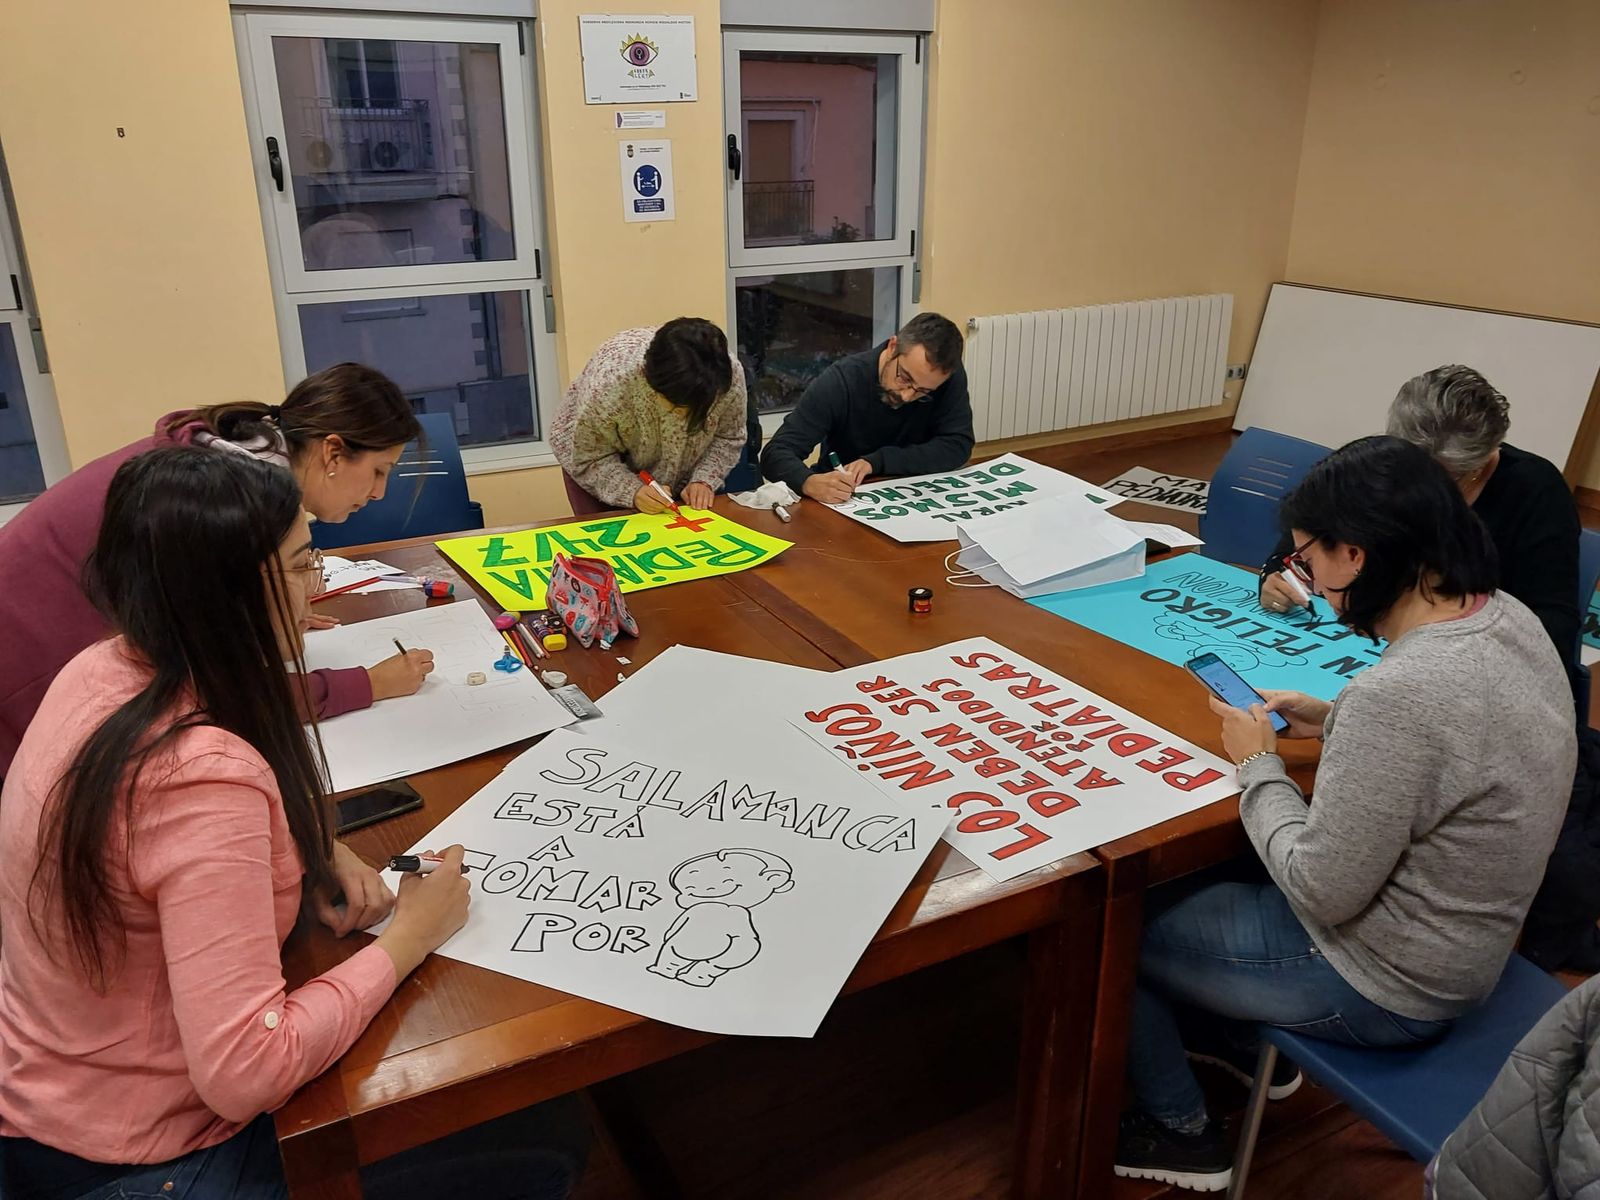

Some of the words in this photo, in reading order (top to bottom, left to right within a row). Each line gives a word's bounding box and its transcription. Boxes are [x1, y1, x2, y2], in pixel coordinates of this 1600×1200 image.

[853, 480, 1039, 521] MISMOS
[1151, 475, 1207, 492] MA
[478, 520, 651, 568] 24/7
[485, 534, 768, 600] PEDIAIA
[1140, 588, 1323, 657] PELIGRO
[1162, 571, 1354, 641] EXTNCION
[856, 675, 939, 717] SER
[1319, 656, 1373, 679] N
[804, 702, 955, 790] NIÑOS
[922, 678, 1124, 790] ATENDIDOS
[950, 652, 1226, 792] PEDIATRAS
[1035, 719, 1094, 753] POR
[922, 722, 1081, 818] DEBEN
[493, 791, 646, 839] ESTÁ
[539, 747, 917, 853] SALAMANCA
[946, 791, 1052, 861] LOS
[528, 835, 574, 862] A
[510, 912, 651, 954] POR
